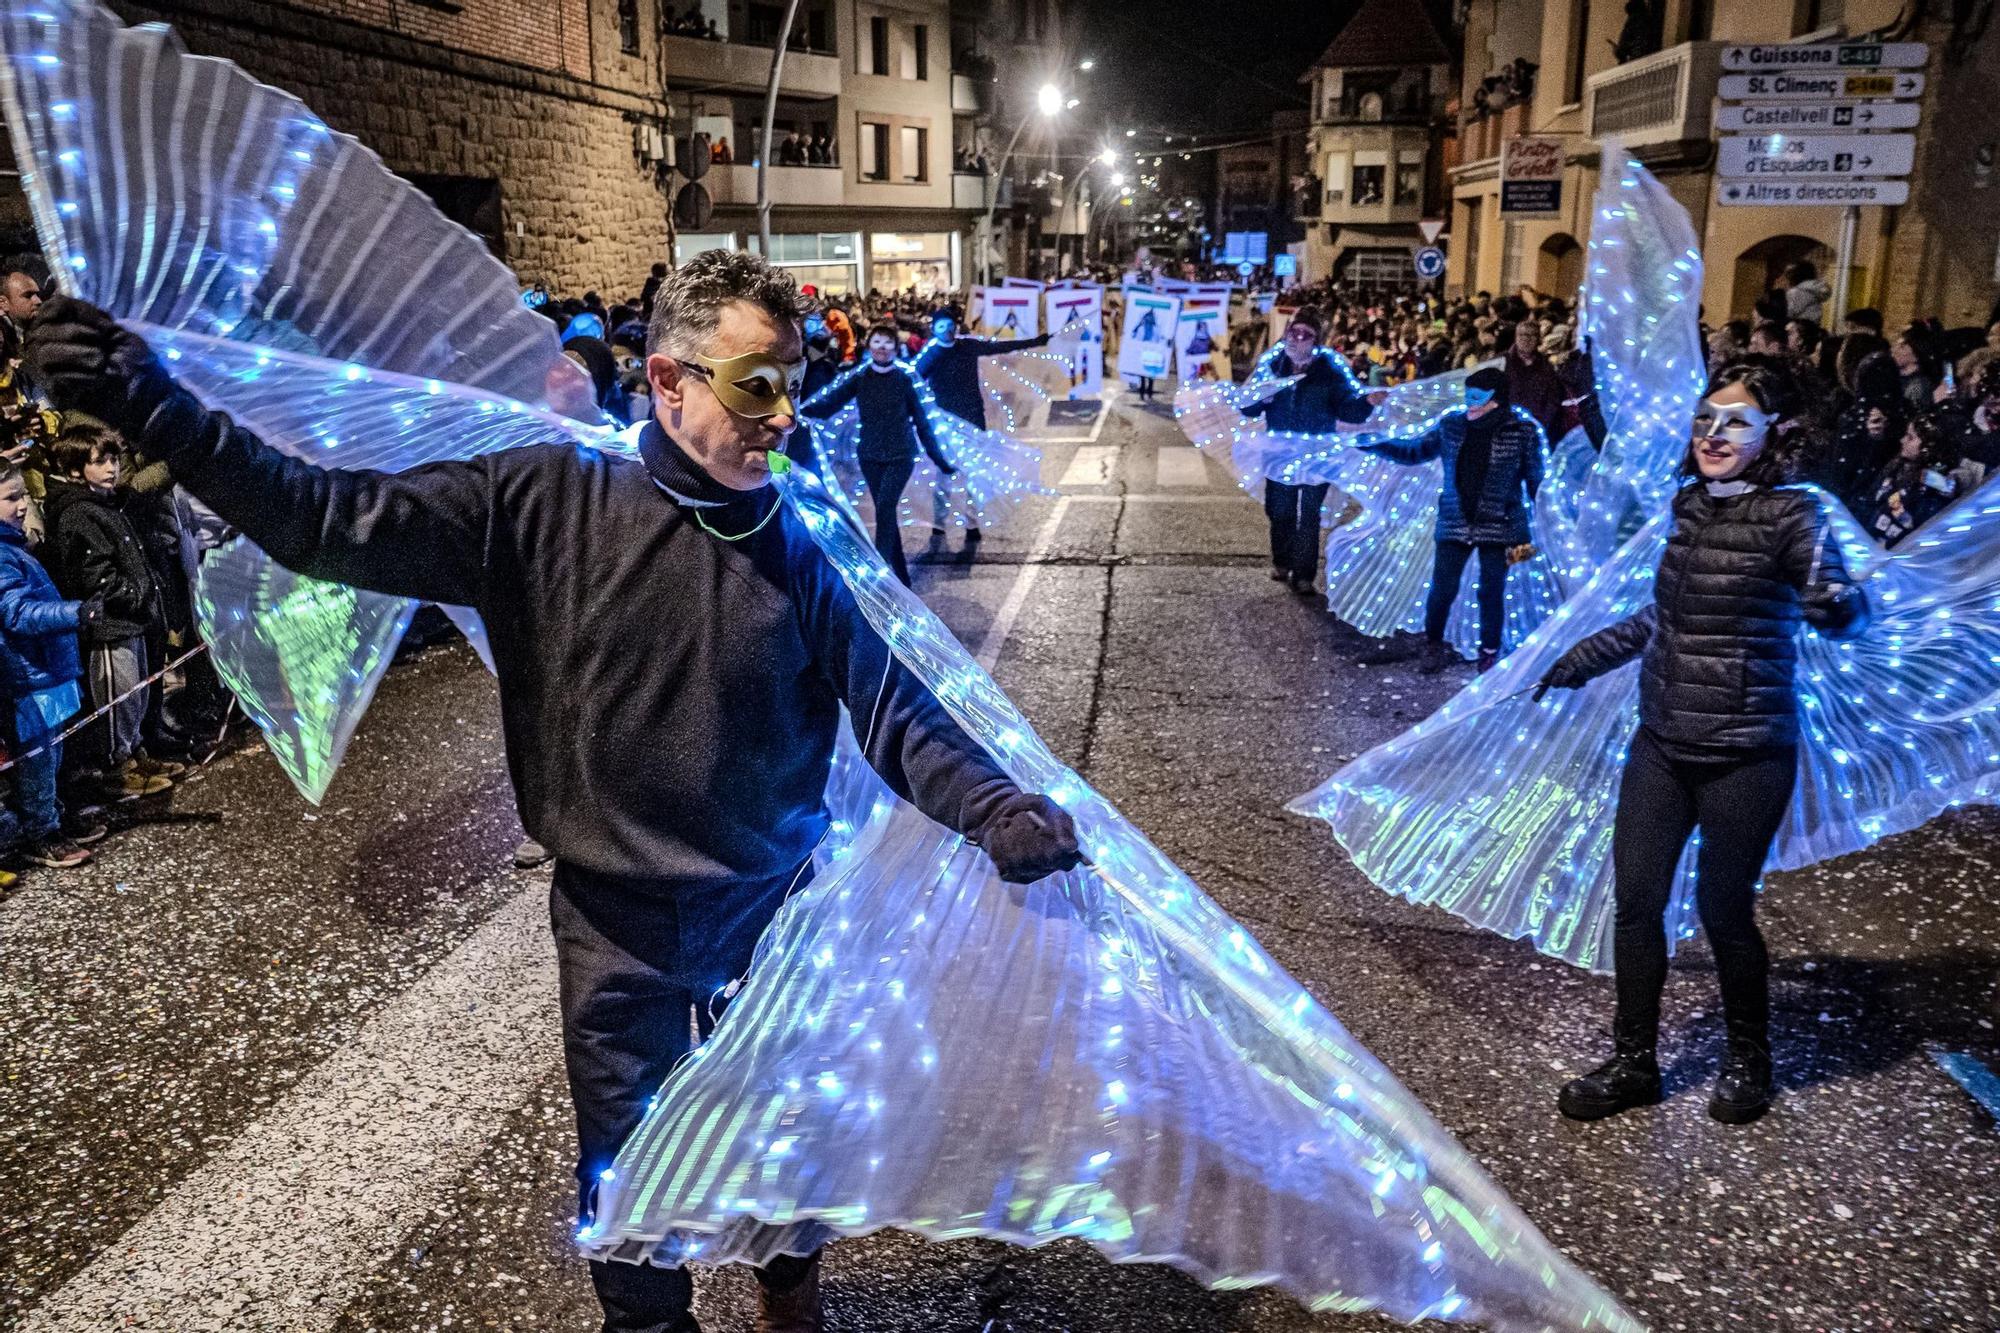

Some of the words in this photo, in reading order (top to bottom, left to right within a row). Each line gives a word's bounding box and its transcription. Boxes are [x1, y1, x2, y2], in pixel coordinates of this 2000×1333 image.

[1749, 47, 1832, 64] Guissona
[1840, 49, 1880, 63] C-451
[1748, 77, 1769, 93] St.
[1774, 77, 1838, 97] Climenç
[1742, 107, 1829, 124] Castellvell
[1748, 138, 1805, 153] Moos
[1745, 156, 1829, 175] d'Esquadra
[1746, 184, 1791, 200] Altres
[1796, 183, 1878, 201] direccions
